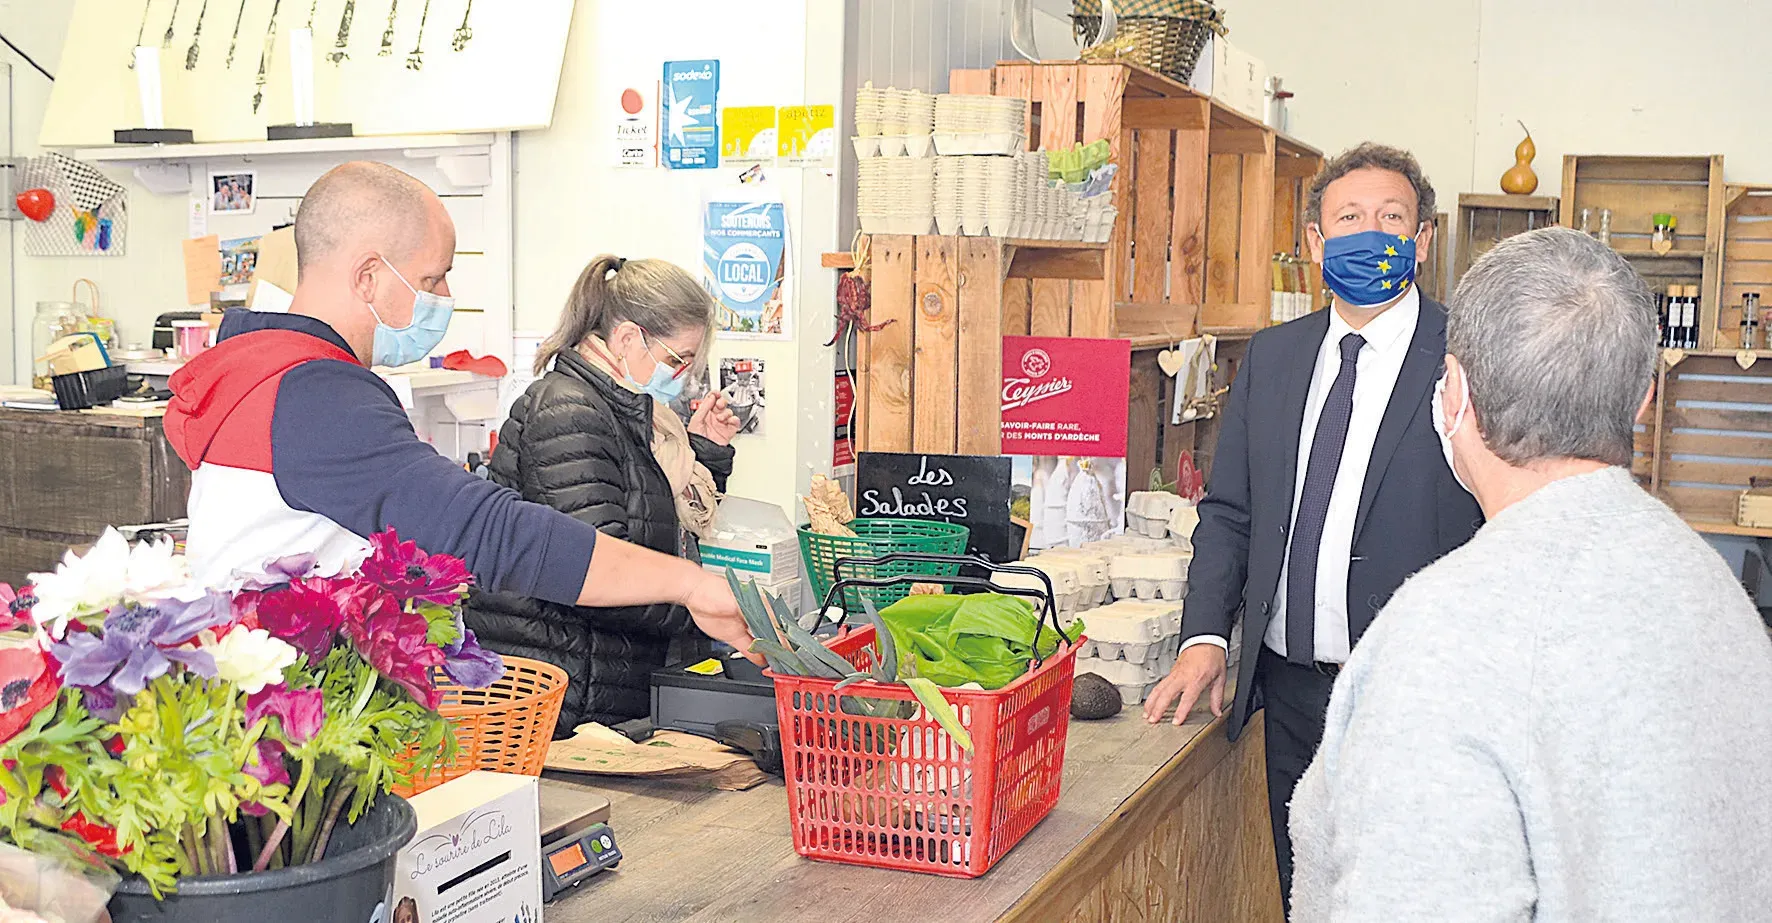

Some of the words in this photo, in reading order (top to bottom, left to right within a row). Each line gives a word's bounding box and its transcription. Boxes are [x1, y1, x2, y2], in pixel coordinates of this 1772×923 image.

[673, 69, 712, 81] sodexo
[617, 125, 647, 134] Ticket
[721, 213, 772, 229] SOUTENONS
[710, 229, 726, 237] NOS
[727, 230, 781, 239] COMMERÇANTS
[724, 262, 764, 283] LOCAL
[1001, 376, 1073, 408] Teyssier
[1006, 432, 1022, 440] DES
[1024, 432, 1053, 441] MONTS
[1054, 431, 1101, 442] D'ARDÈCHE
[860, 486, 968, 518] Salades
[716, 553, 736, 562] Medical
[736, 556, 748, 565] Face
[748, 558, 764, 566] Mask
[410, 852, 432, 879] Le
[435, 845, 469, 869] sourire
[470, 829, 482, 849] de
[483, 814, 512, 844] Lila
